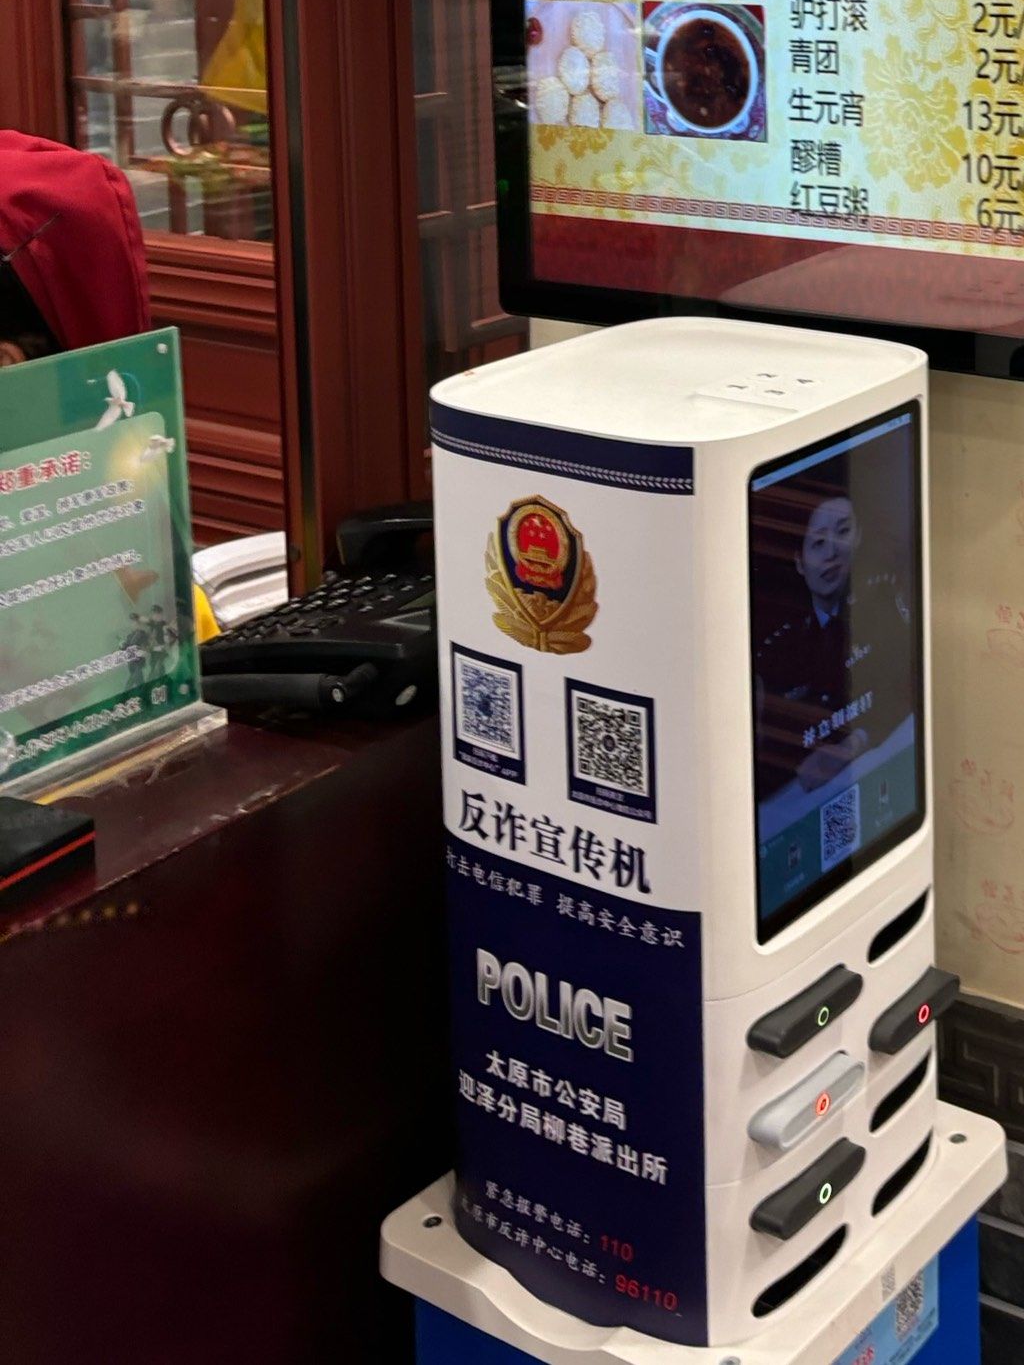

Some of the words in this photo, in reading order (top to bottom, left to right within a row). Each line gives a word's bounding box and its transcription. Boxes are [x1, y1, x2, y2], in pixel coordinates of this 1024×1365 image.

[789, 37, 839, 75] 青团
[788, 87, 865, 127] 生元宵
[790, 139, 842, 176] 醪糟
[456, 788, 652, 895] 反诈宣传机
[446, 845, 544, 906] 打击电信犯罪
[556, 892, 685, 948] 提高安全意识
[476, 948, 634, 1063] POLICE
[486, 1050, 626, 1130] 太原市公安局
[459, 1069, 668, 1185] 迎泽分局柳巷派出所
[599, 1234, 633, 1261] 110
[615, 1274, 678, 1311] 96110
